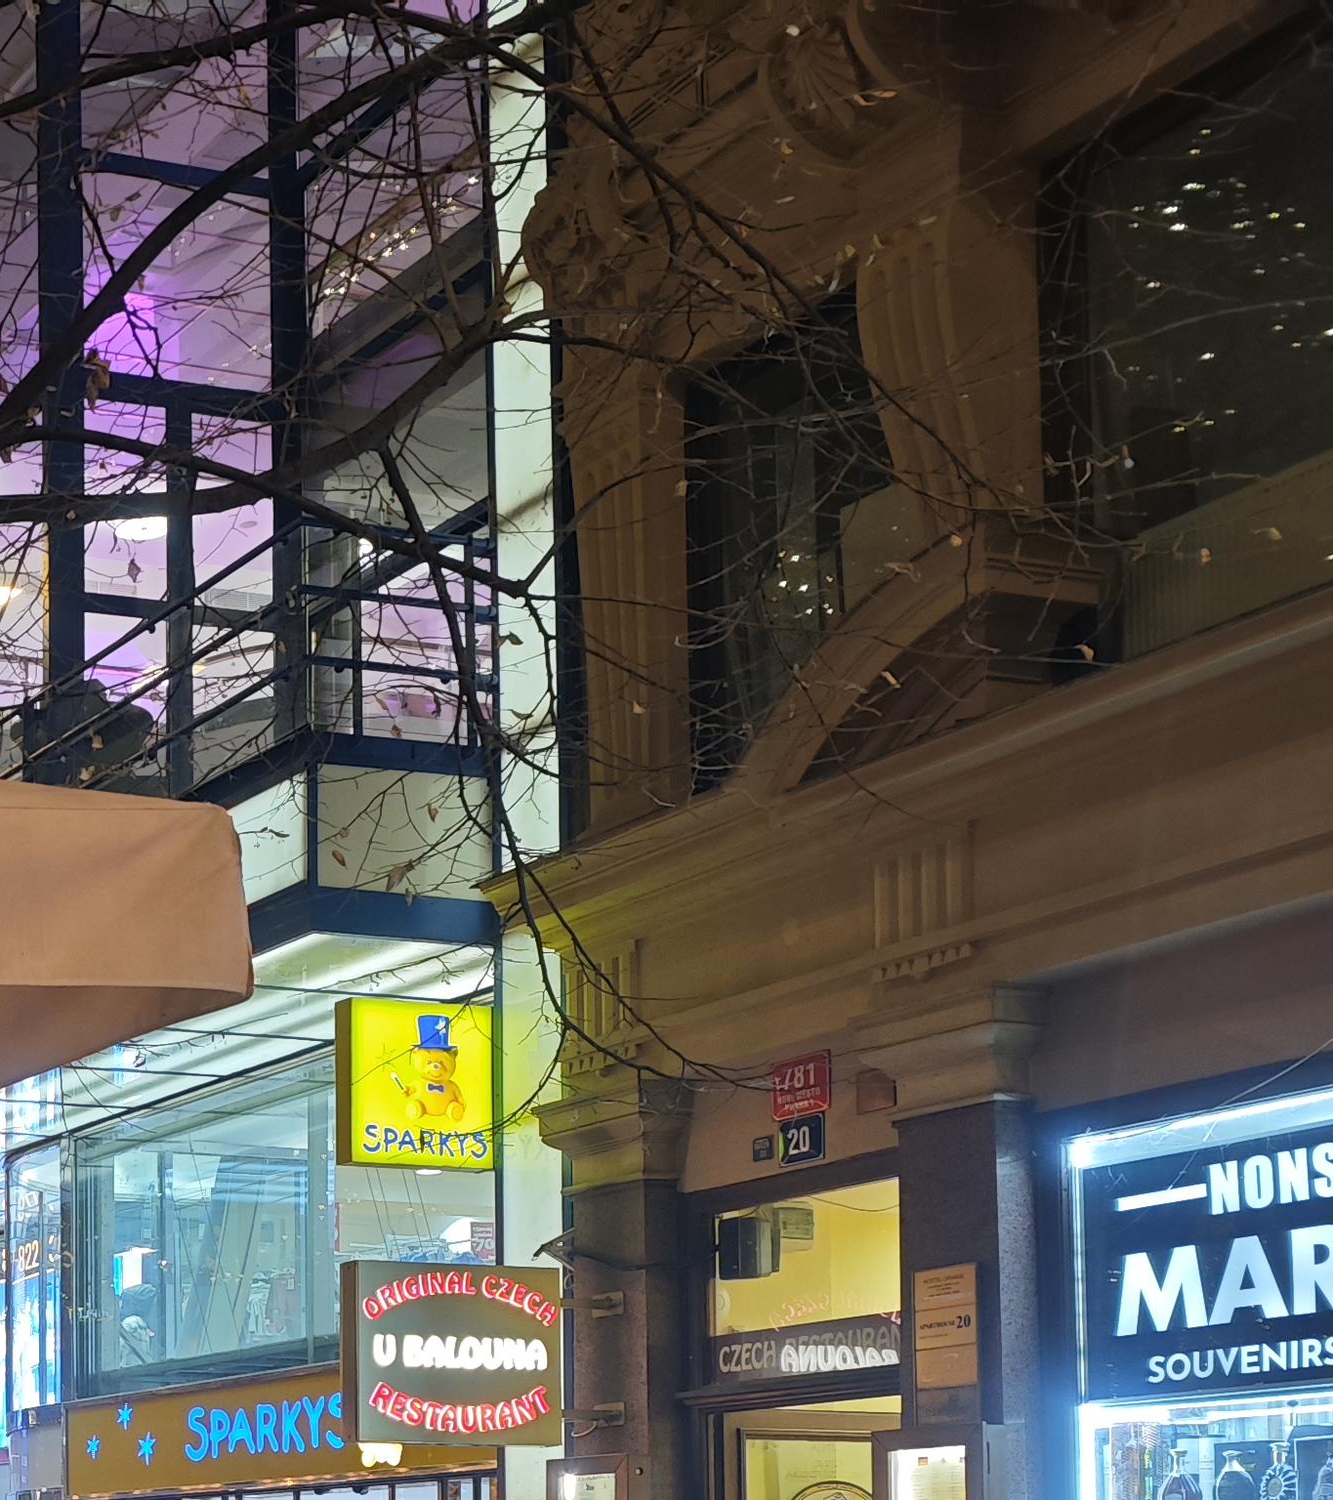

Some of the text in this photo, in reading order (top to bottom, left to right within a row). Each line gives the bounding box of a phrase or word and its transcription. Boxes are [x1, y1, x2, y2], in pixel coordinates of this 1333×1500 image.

[363, 1124, 490, 1160] SPARKYS
[787, 1126, 810, 1155] 20
[1208, 1141, 1333, 1216] NONS
[362, 1271, 560, 1327] ORIGINAL CZECH
[1115, 1224, 1333, 1337] MAR
[956, 1314, 972, 1329] 20
[372, 1333, 549, 1371] U BALOUNA
[719, 1340, 776, 1373] CZECH
[1147, 1338, 1333, 1384] SOUVENIRS
[184, 1392, 344, 1463] SPARKYS
[369, 1381, 552, 1434] RESTAURANT
